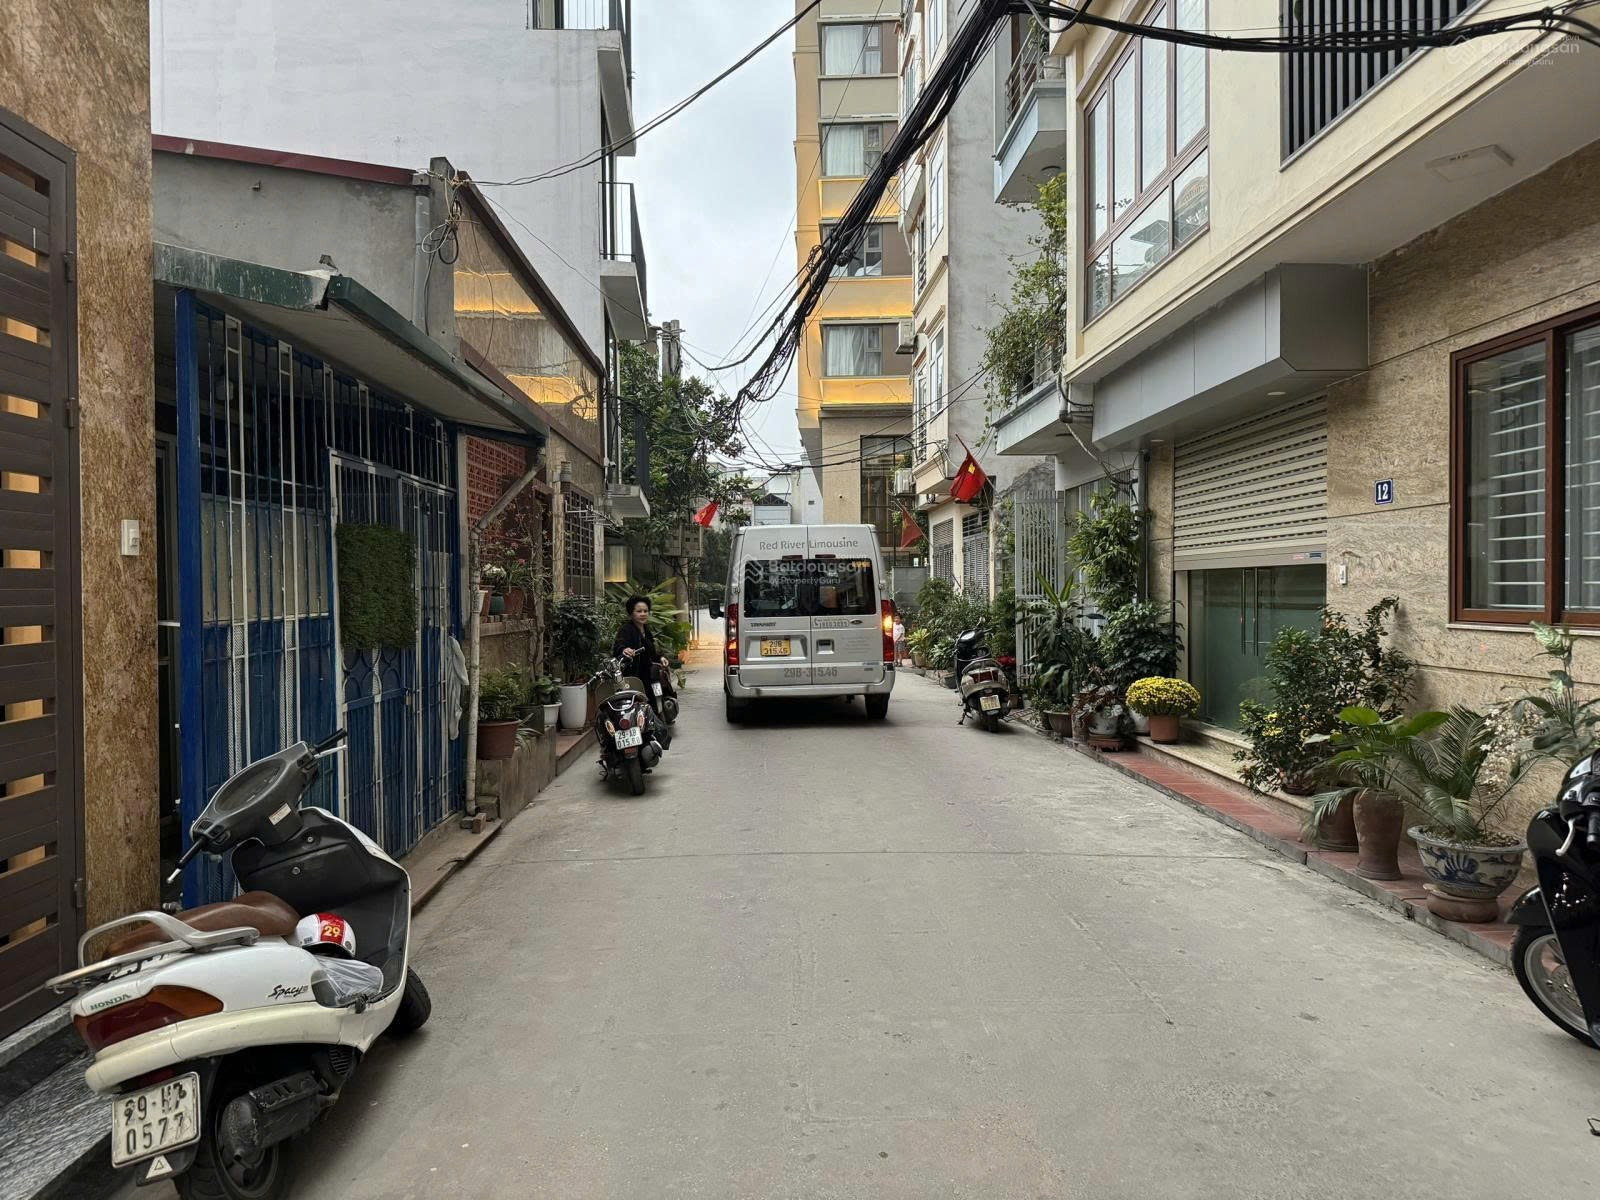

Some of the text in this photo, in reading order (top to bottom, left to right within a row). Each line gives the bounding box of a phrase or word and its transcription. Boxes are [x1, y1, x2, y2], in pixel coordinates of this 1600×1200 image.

[1377, 483, 1389, 500] 12
[760, 539, 859, 550] Red River Limousine
[325, 926, 341, 938] 29
[268, 984, 304, 1000] Spacy
[90, 993, 132, 1010] HONDA
